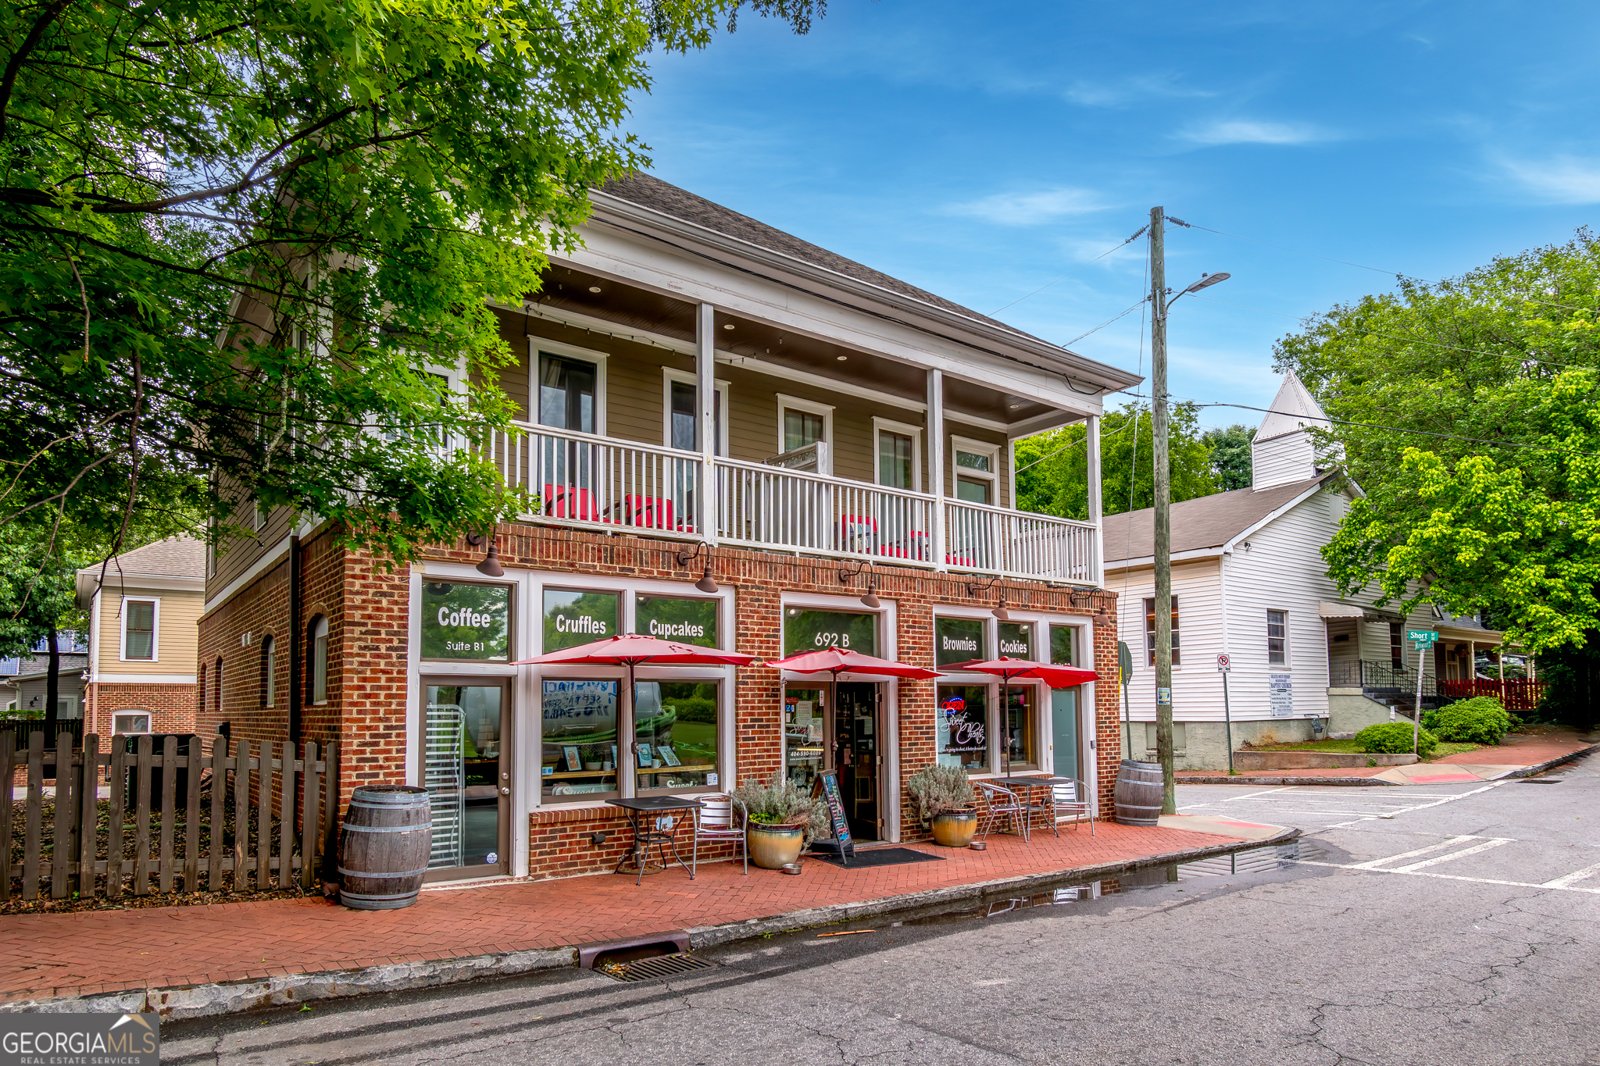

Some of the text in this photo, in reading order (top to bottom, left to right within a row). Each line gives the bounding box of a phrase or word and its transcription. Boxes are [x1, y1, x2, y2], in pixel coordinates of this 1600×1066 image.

[437, 606, 492, 628] Coffee
[556, 614, 607, 635] Cruffles
[649, 618, 704, 640] Cupcakes
[1410, 631, 1428, 640] Short
[446, 640, 485, 652] Suite B1
[814, 631, 850, 648] 692 B
[942, 635, 977, 652] Brownies
[1000, 639, 1028, 655] Cookies
[942, 698, 964, 711] OPEN
